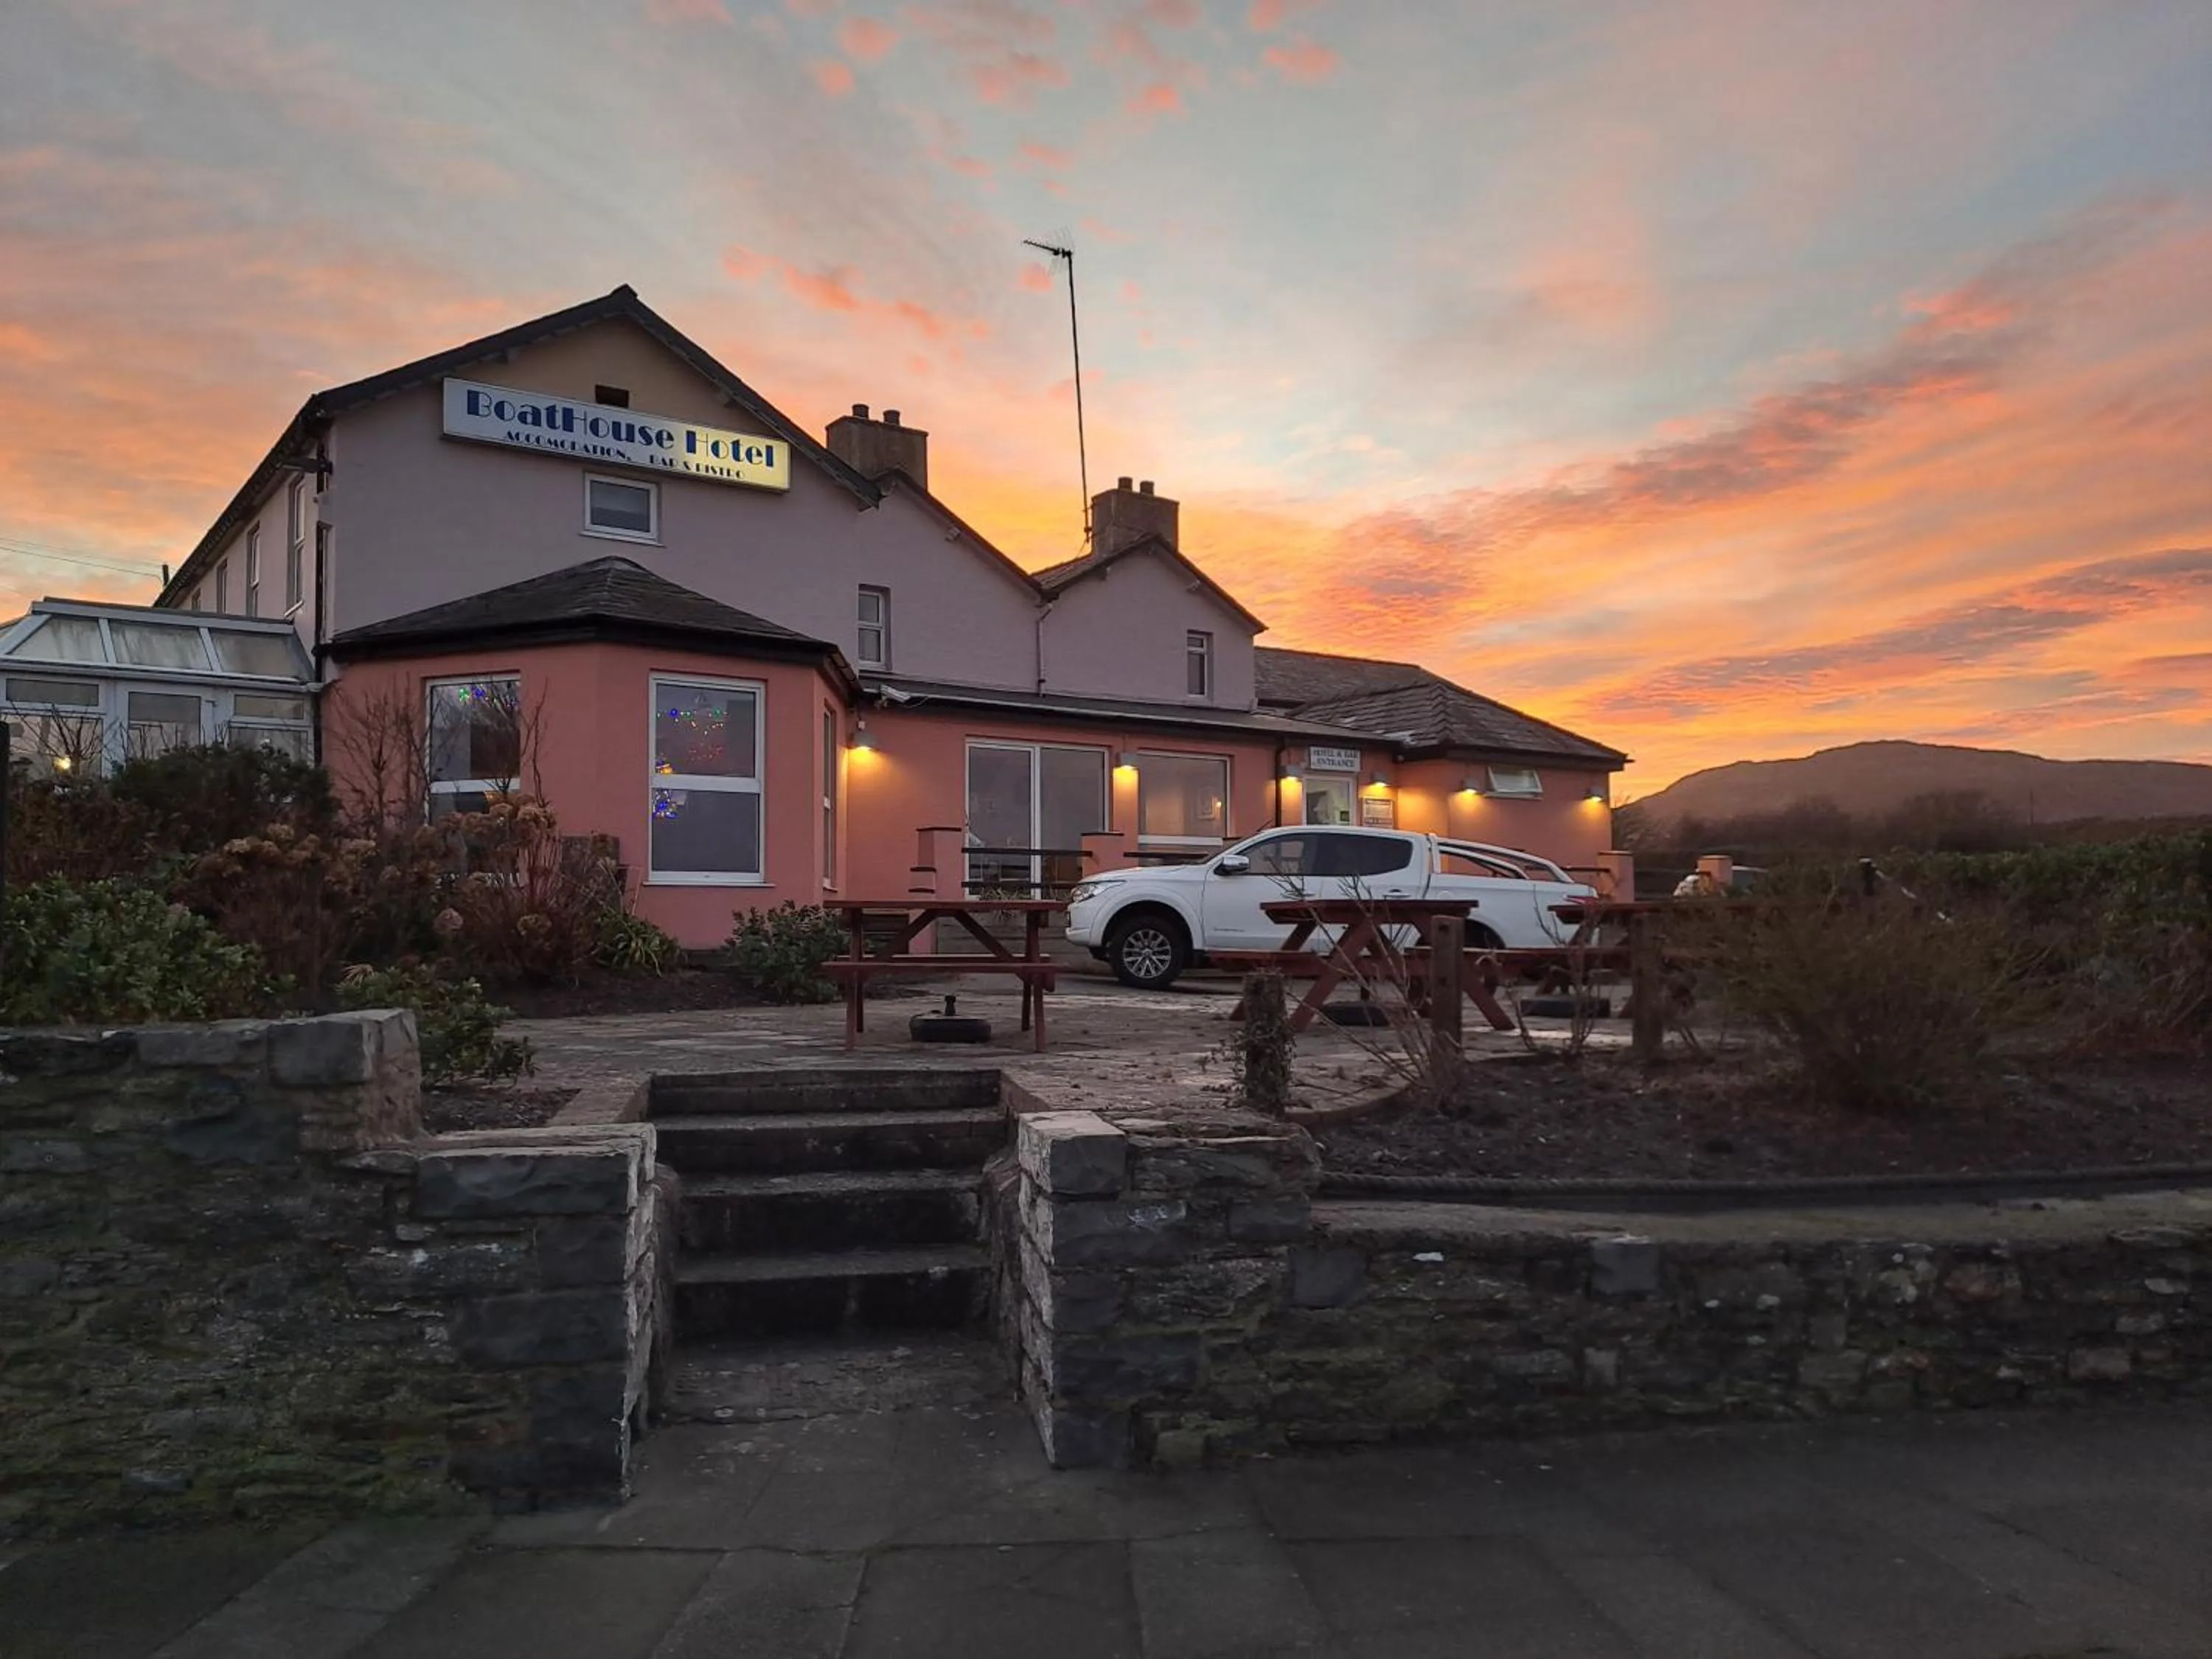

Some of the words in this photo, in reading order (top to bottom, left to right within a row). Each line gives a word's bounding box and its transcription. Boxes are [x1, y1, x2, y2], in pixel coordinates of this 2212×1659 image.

[467, 389, 675, 449] BoatHouse
[685, 430, 774, 467] Hotel
[1316, 757, 1354, 768] ENTRANCE
